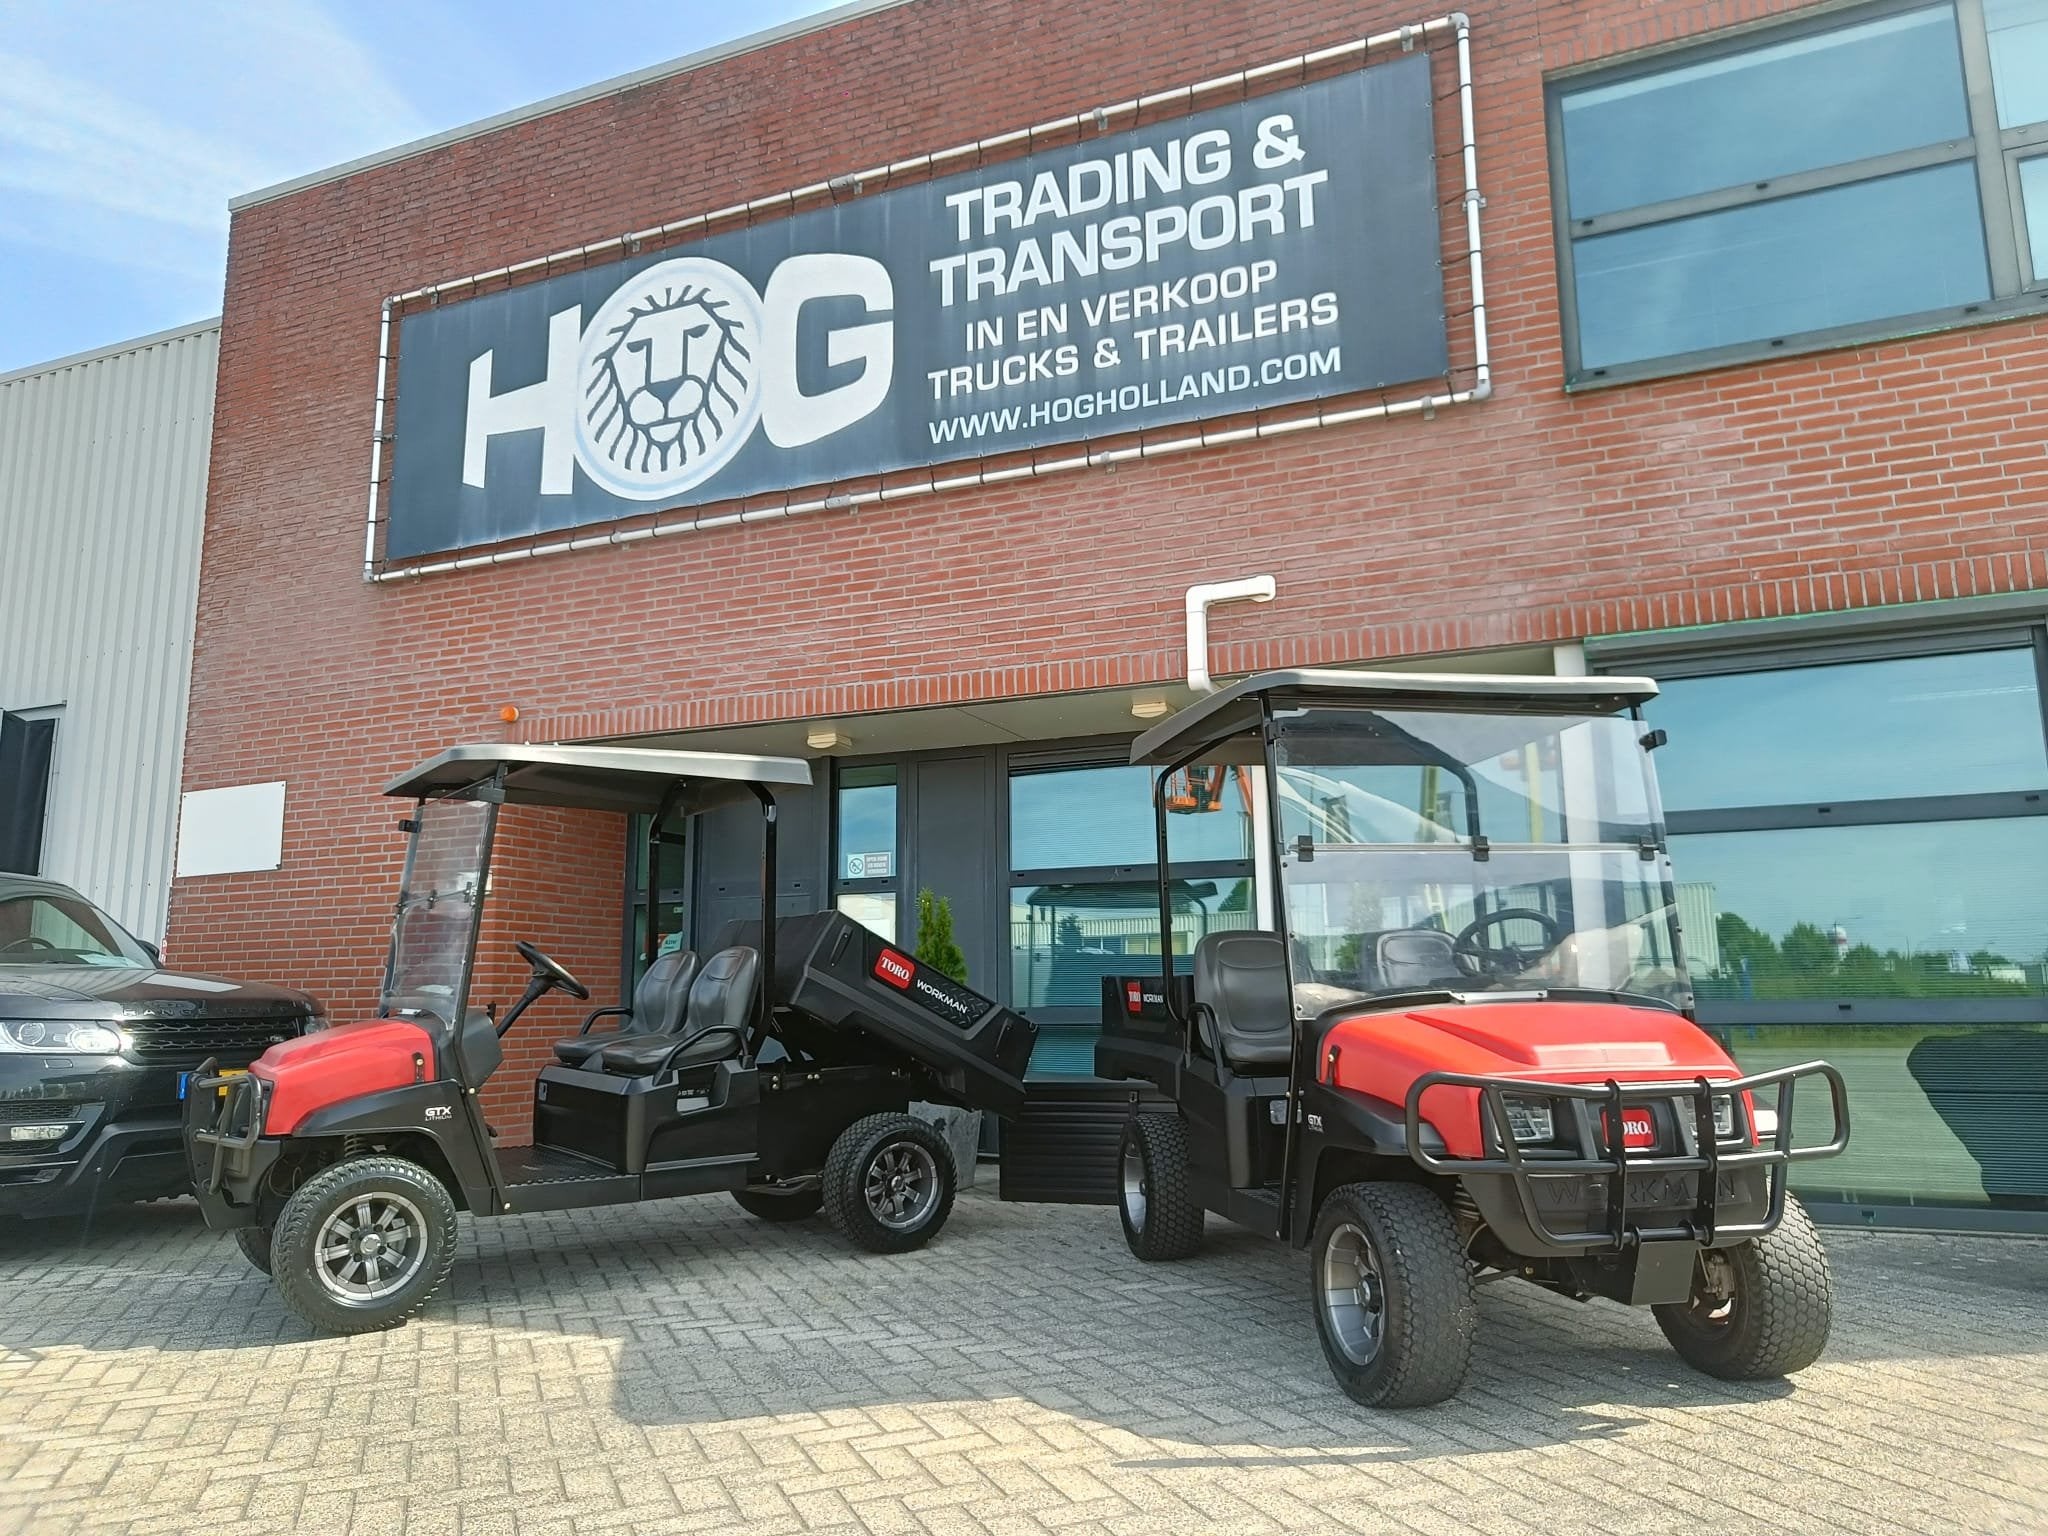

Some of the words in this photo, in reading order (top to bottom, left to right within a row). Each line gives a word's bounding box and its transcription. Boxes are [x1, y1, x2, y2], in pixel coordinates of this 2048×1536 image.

[945, 129, 1232, 242] TRADING
[1252, 114, 1306, 170] &
[929, 169, 1329, 307] TRANSPORT
[927, 345, 1079, 400] TRUCKS
[1093, 338, 1121, 369] &
[1133, 292, 1339, 361] TRAILERS
[966, 316, 1003, 352] IN
[1017, 303, 1068, 342] EN
[1081, 259, 1278, 327] VERKOOP
[462, 252, 895, 501] HOG
[929, 346, 1342, 445] WWW.HOGHOLLAND.COM
[881, 957, 910, 981] TORO
[916, 979, 969, 1014] WORKMAN
[425, 1106, 452, 1116] GTX
[1546, 1174, 1737, 1205] WRKMN
